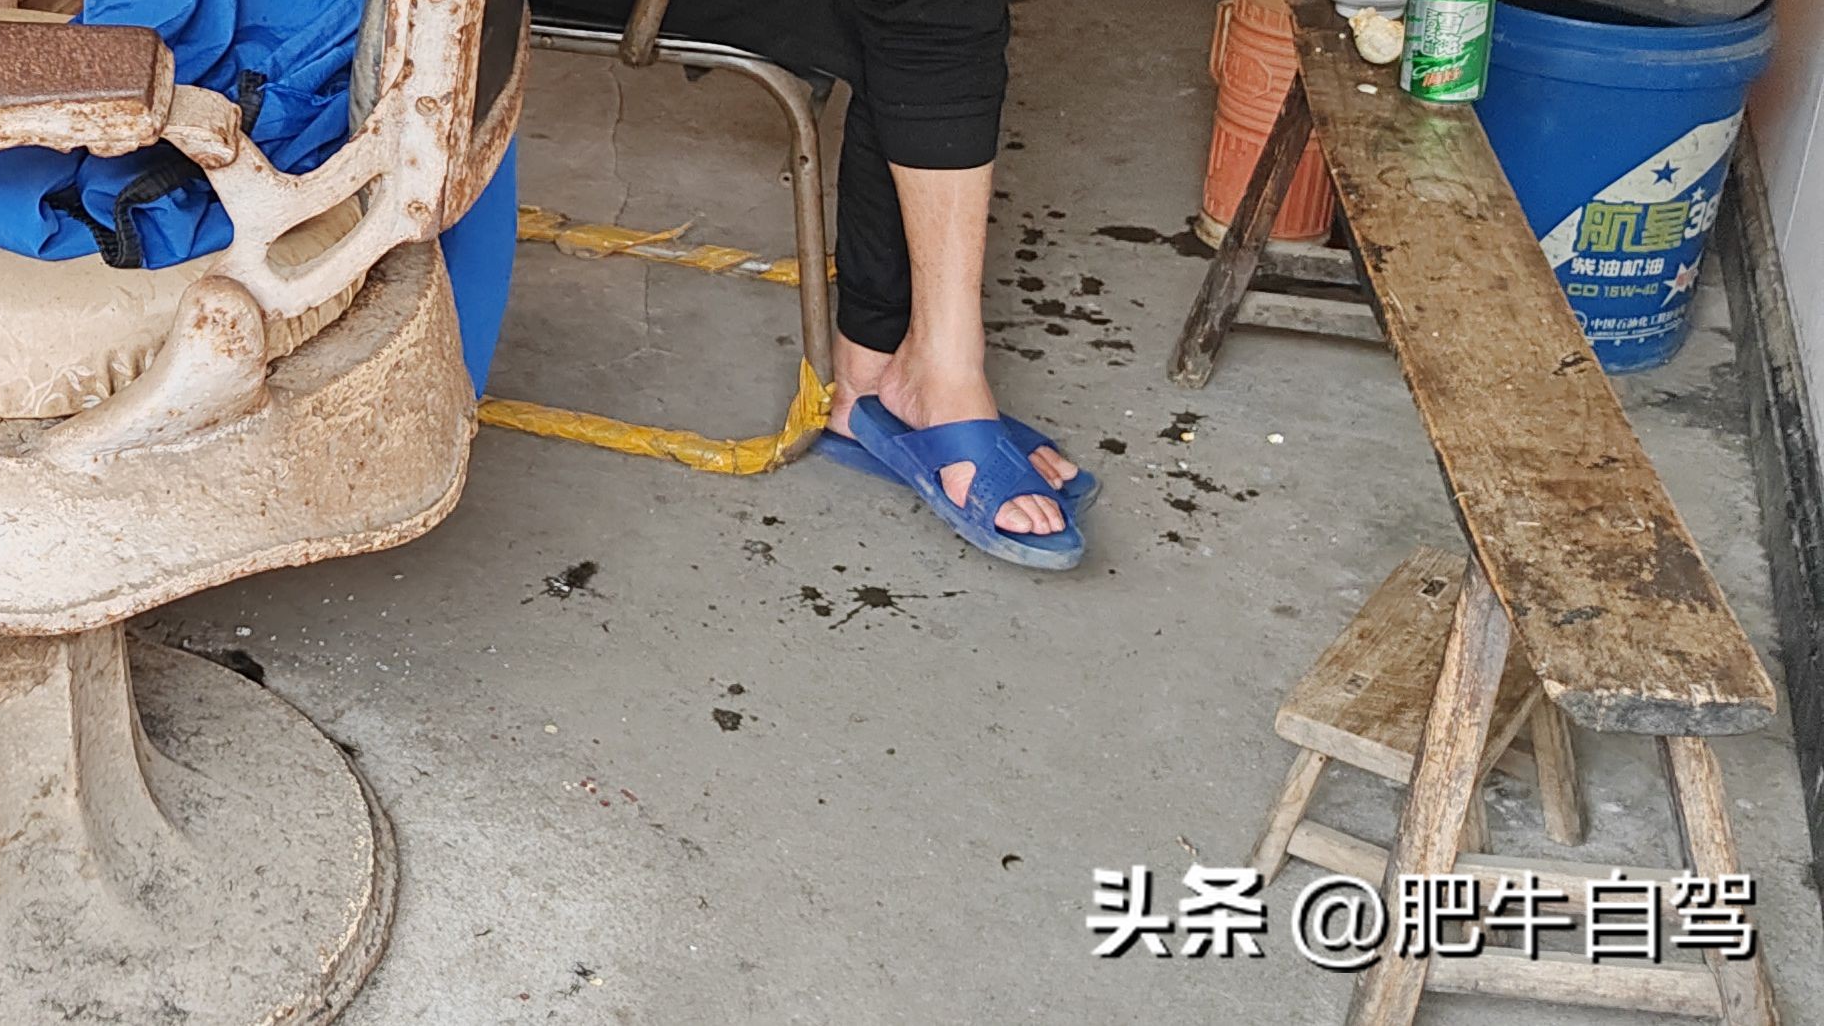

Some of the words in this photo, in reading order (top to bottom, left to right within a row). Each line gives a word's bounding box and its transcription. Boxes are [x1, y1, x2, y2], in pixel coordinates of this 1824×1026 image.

[1577, 202, 1690, 253] 航星
[1570, 257, 1665, 277] 柴油机油
[1567, 283, 1598, 297] CD
